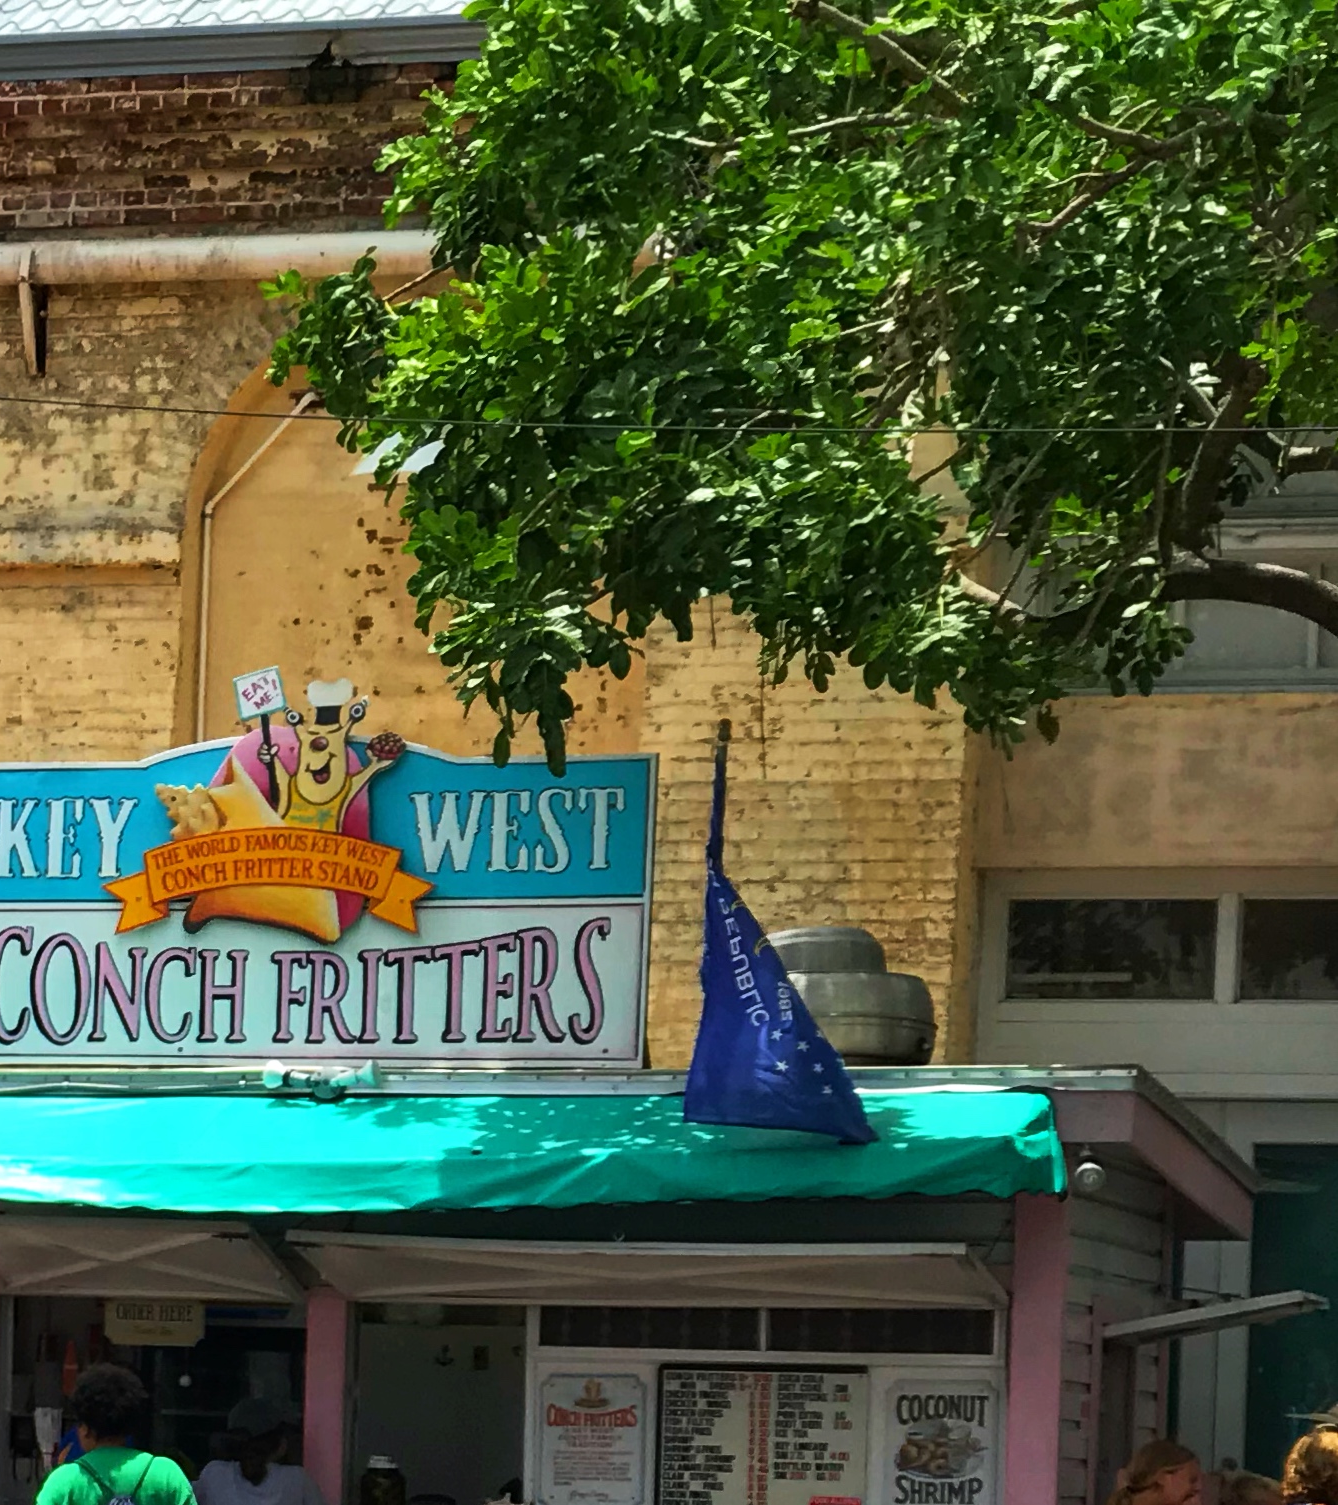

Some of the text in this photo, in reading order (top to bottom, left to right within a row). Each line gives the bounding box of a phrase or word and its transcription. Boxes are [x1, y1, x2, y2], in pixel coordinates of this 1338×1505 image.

[241, 676, 269, 702] EAT
[412, 787, 624, 873] WEST
[151, 834, 390, 870] THE WORLD FAMOUS KEY WEST
[162, 857, 379, 893] CONCH FRITTER STAND
[270, 917, 612, 1045] FRITTERS
[159, 1304, 195, 1322] HERE
[896, 1394, 989, 1428] COCONUT
[894, 1474, 983, 1505] SHRIMP
